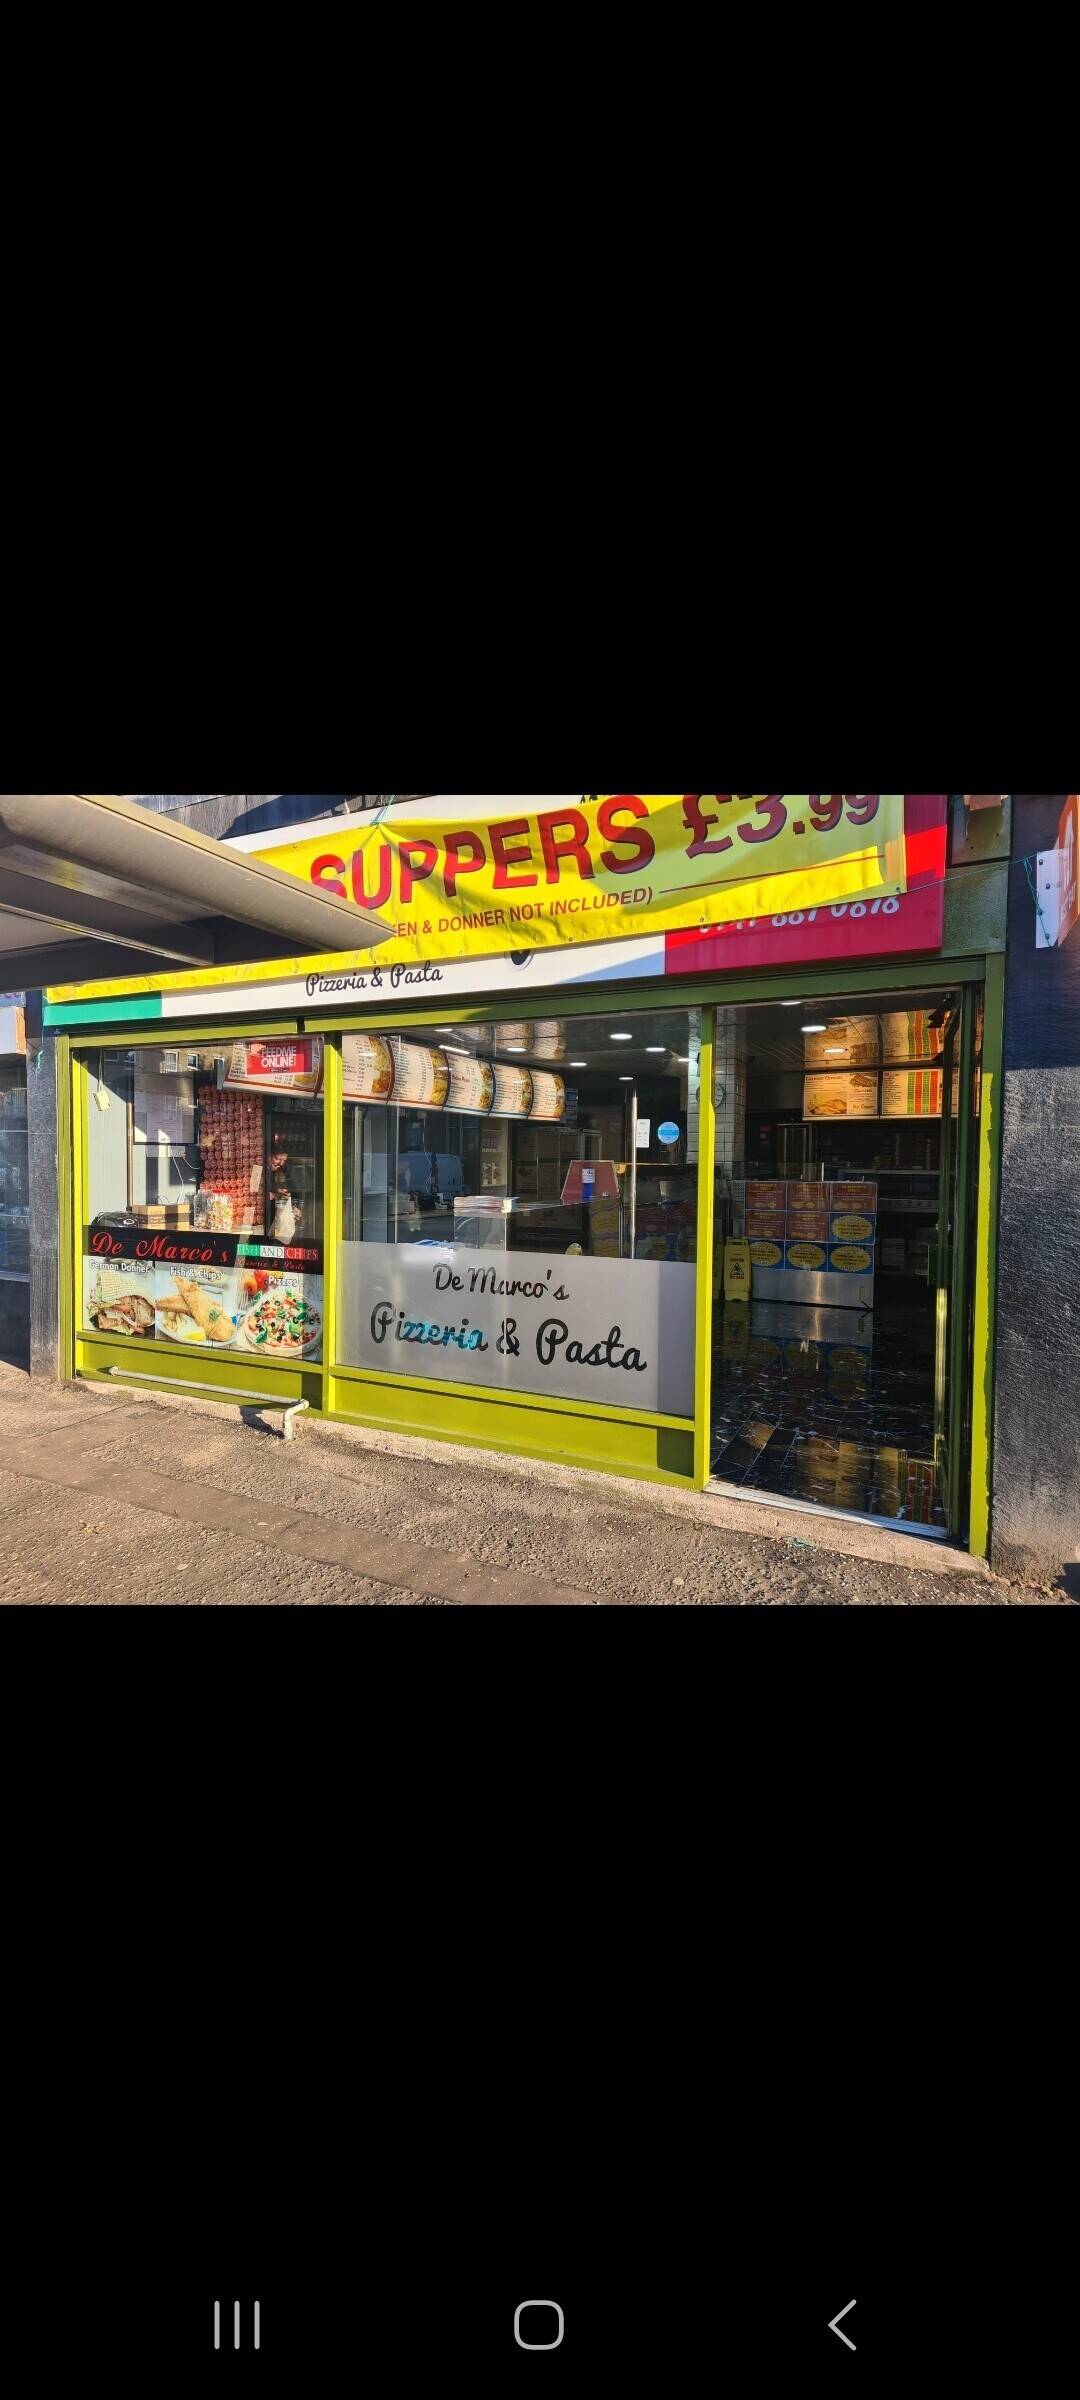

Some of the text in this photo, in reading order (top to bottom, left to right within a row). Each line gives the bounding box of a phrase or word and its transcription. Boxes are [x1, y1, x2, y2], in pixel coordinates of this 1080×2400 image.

[311, 794, 880, 911] SUPPERS £3.99
[422, 919, 433, 934] &
[438, 908, 506, 933] DONNER
[510, 903, 545, 923] NOT
[549, 886, 653, 917] INCLUDED)
[305, 960, 443, 997] Pizzeria & Pasta
[261, 1057, 294, 1068] ONLINE
[91, 1231, 124, 1255] De
[261, 1246, 284, 1258] AND
[286, 1247, 318, 1261] CHIPS
[89, 1259, 119, 1271] German
[170, 1266, 222, 1281] Fish & Chips
[433, 1263, 570, 1301] De Marco's
[370, 1301, 648, 1372] Pizzeria & Pasta
